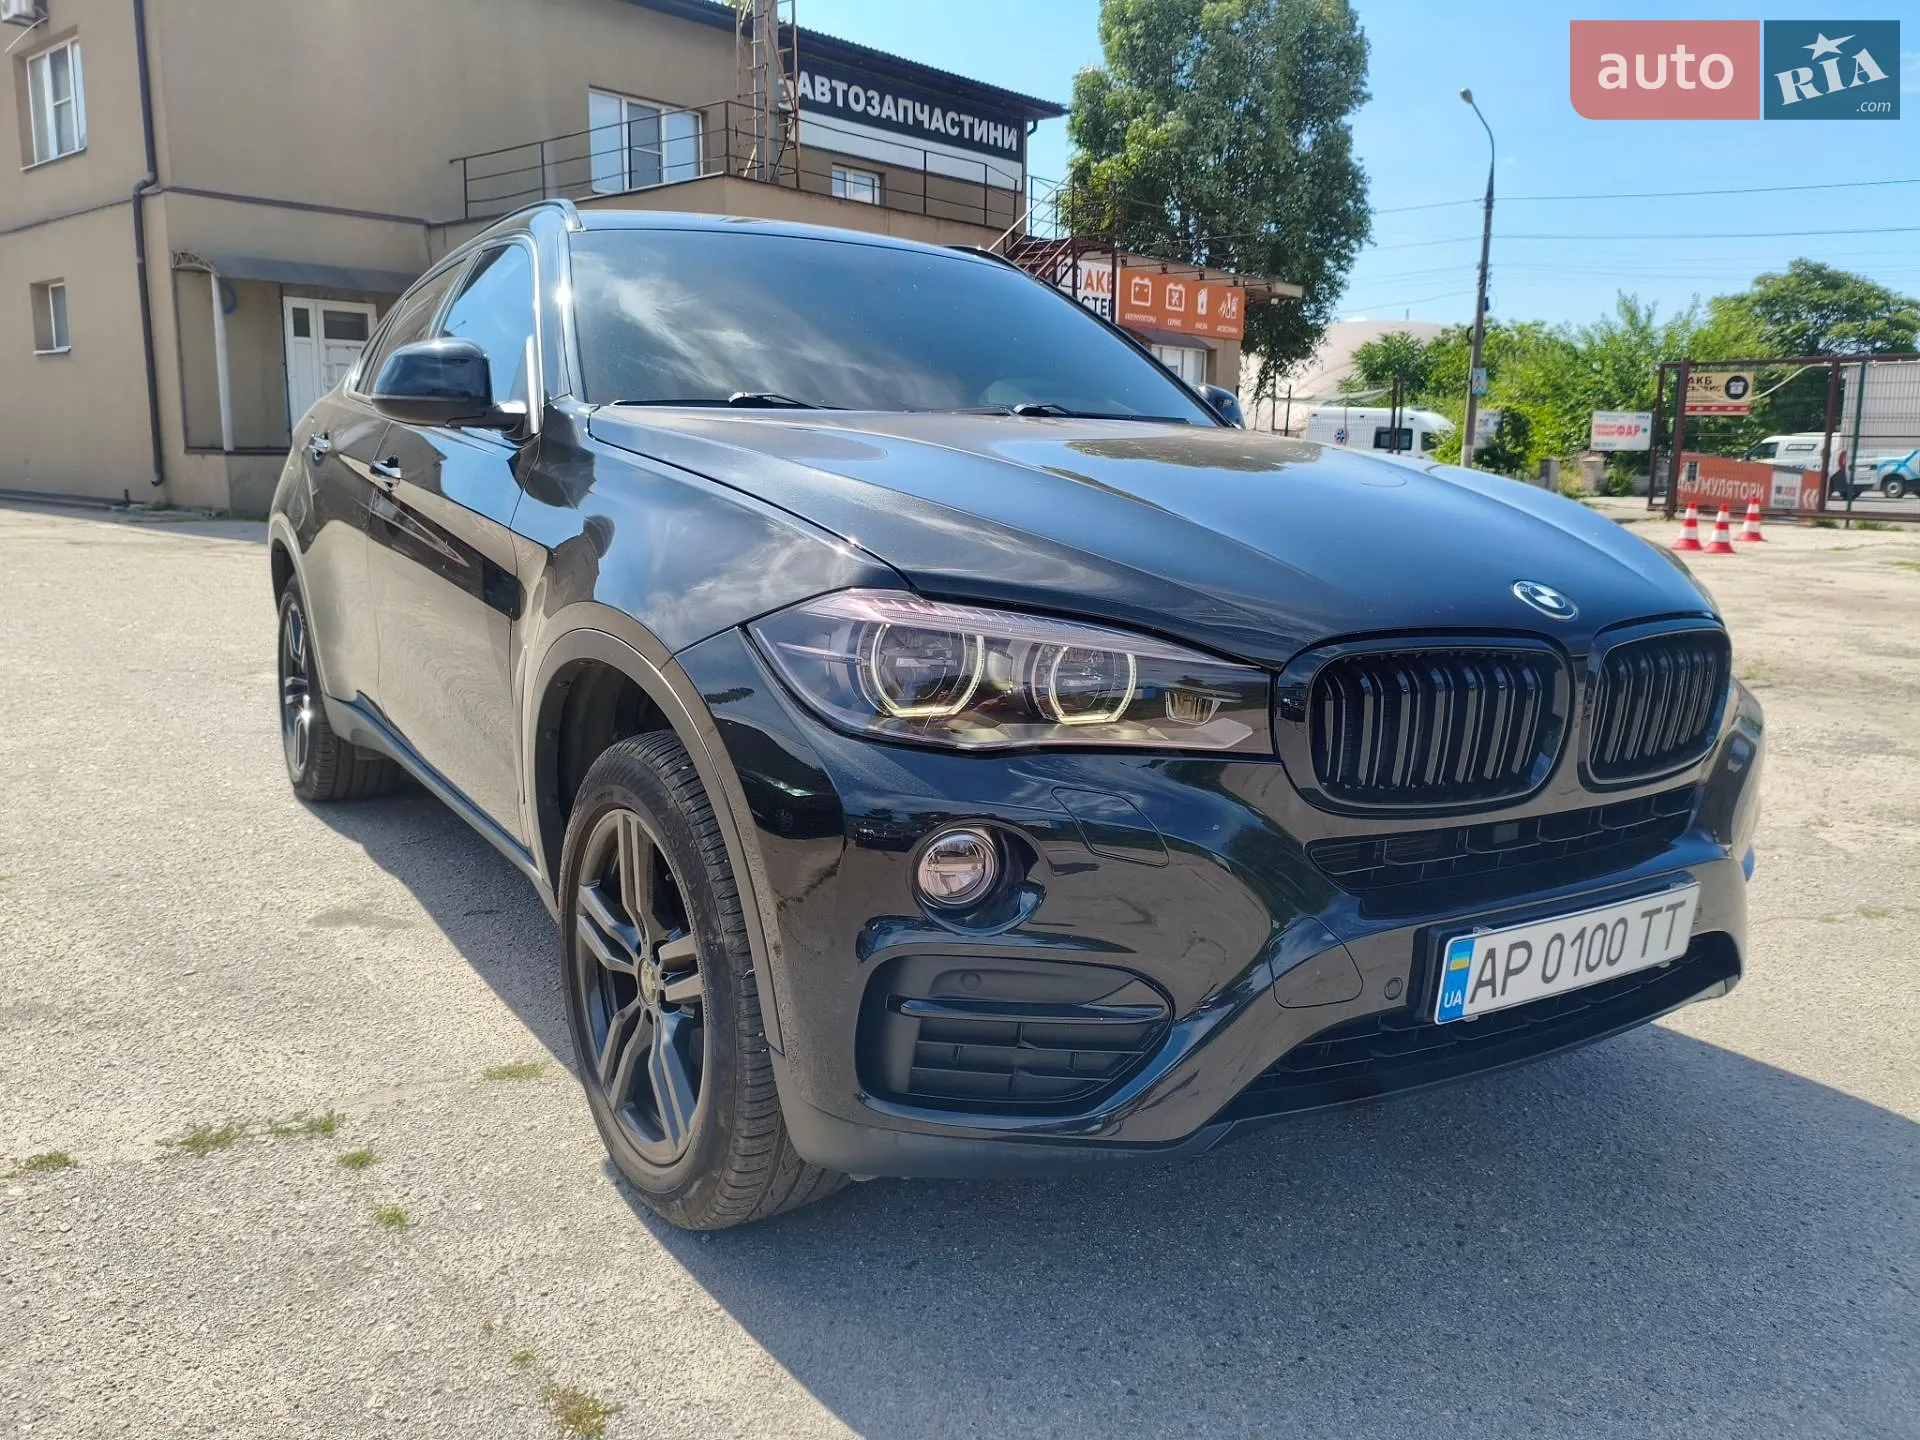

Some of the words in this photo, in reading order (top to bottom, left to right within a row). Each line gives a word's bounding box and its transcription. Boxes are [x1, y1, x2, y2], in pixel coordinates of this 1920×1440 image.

[799, 70, 1018, 152] АВТОЗАПЧАСТИНИ
[1469, 940, 1533, 1004] AP
[1541, 916, 1629, 984] 0100
[1640, 900, 1687, 958] TT
[1443, 990, 1463, 1009] UA
